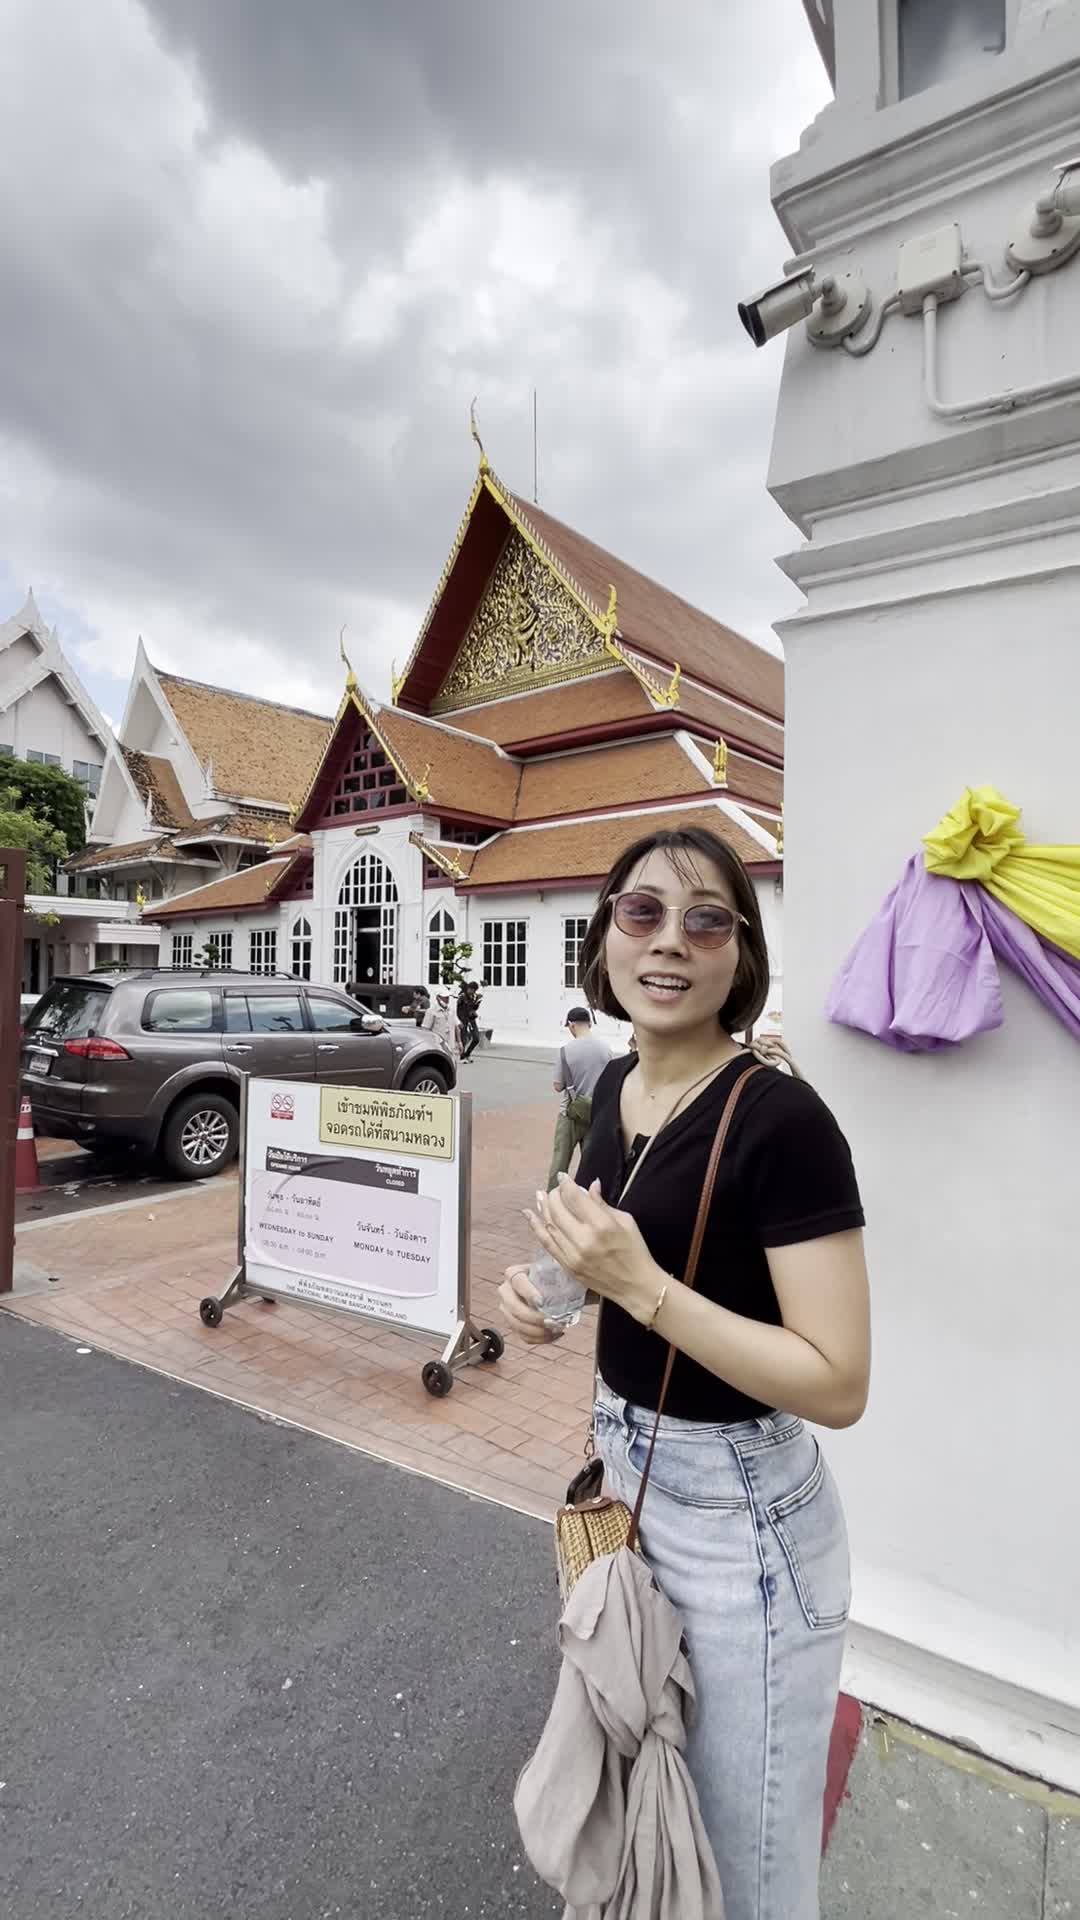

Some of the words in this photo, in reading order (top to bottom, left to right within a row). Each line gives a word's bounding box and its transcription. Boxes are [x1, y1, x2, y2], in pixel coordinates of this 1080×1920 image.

[337, 1097, 433, 1122] เข้าชมพิพิธภัณฑ์ฯ
[326, 1119, 445, 1147] จอดรถได้ที่สนามหลวง
[259, 1222, 296, 1235] WEDNESDAY
[307, 1231, 334, 1243] SUNDAY
[353, 1241, 384, 1254] MONDAY
[386, 1248, 394, 1256] to
[396, 1250, 431, 1264] TUESDAY
